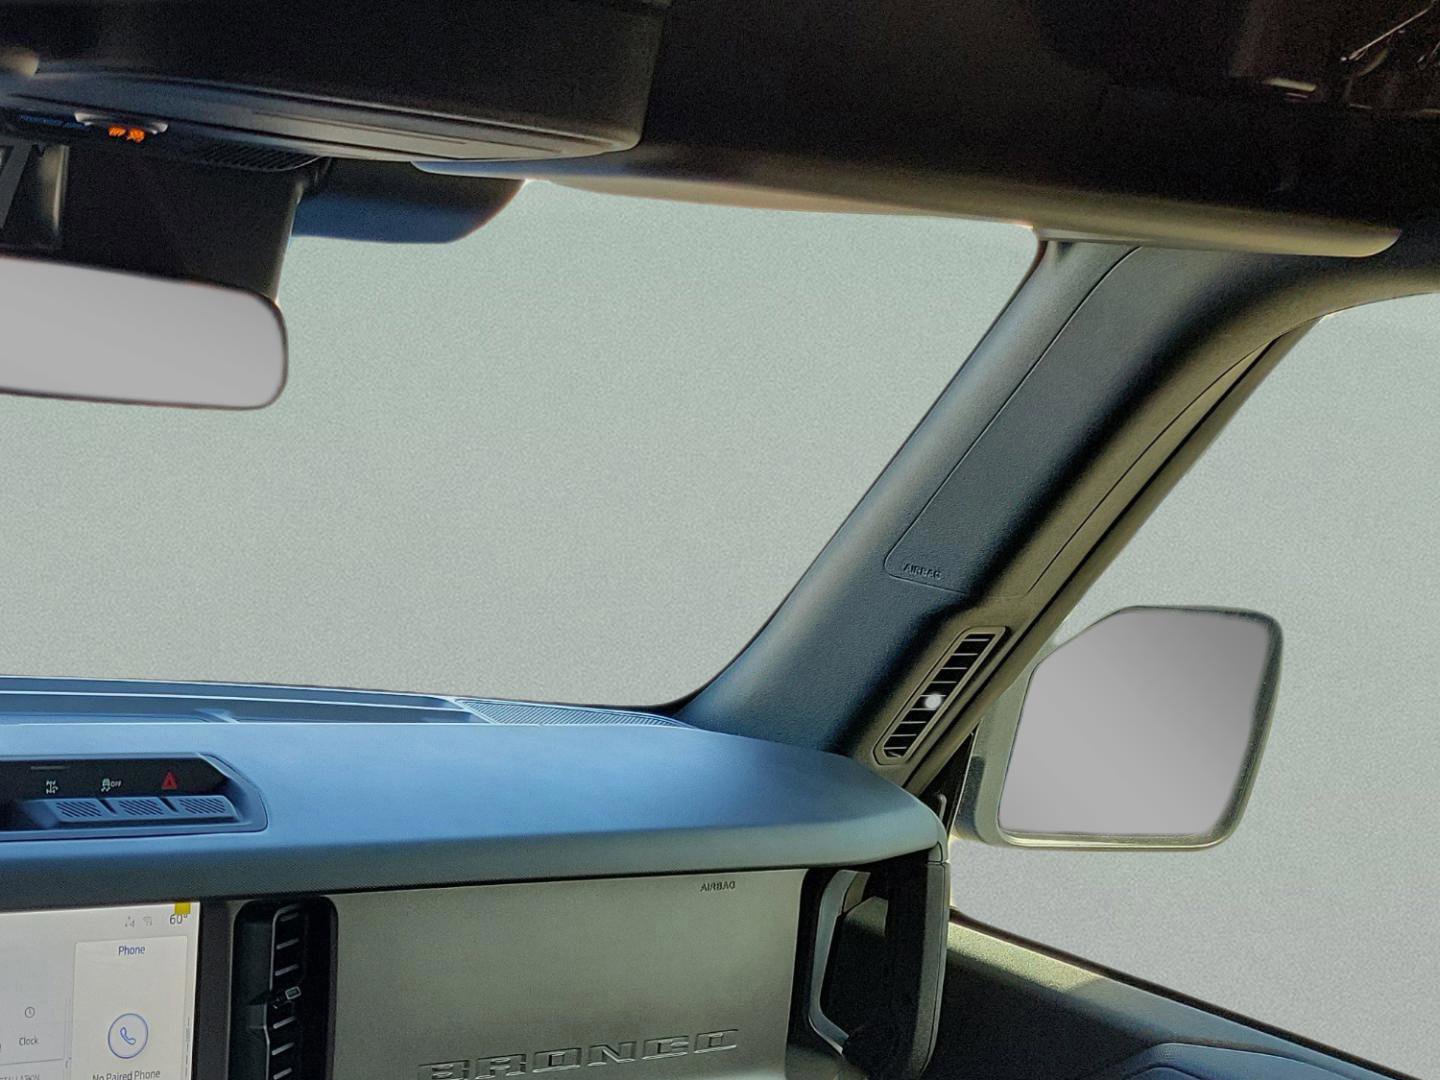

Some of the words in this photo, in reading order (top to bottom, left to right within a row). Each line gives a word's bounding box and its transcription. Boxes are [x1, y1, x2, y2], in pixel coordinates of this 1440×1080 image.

[700, 881, 736, 892] AIRBAG
[118, 945, 145, 957] Phone
[18, 1037, 39, 1047] Clock
